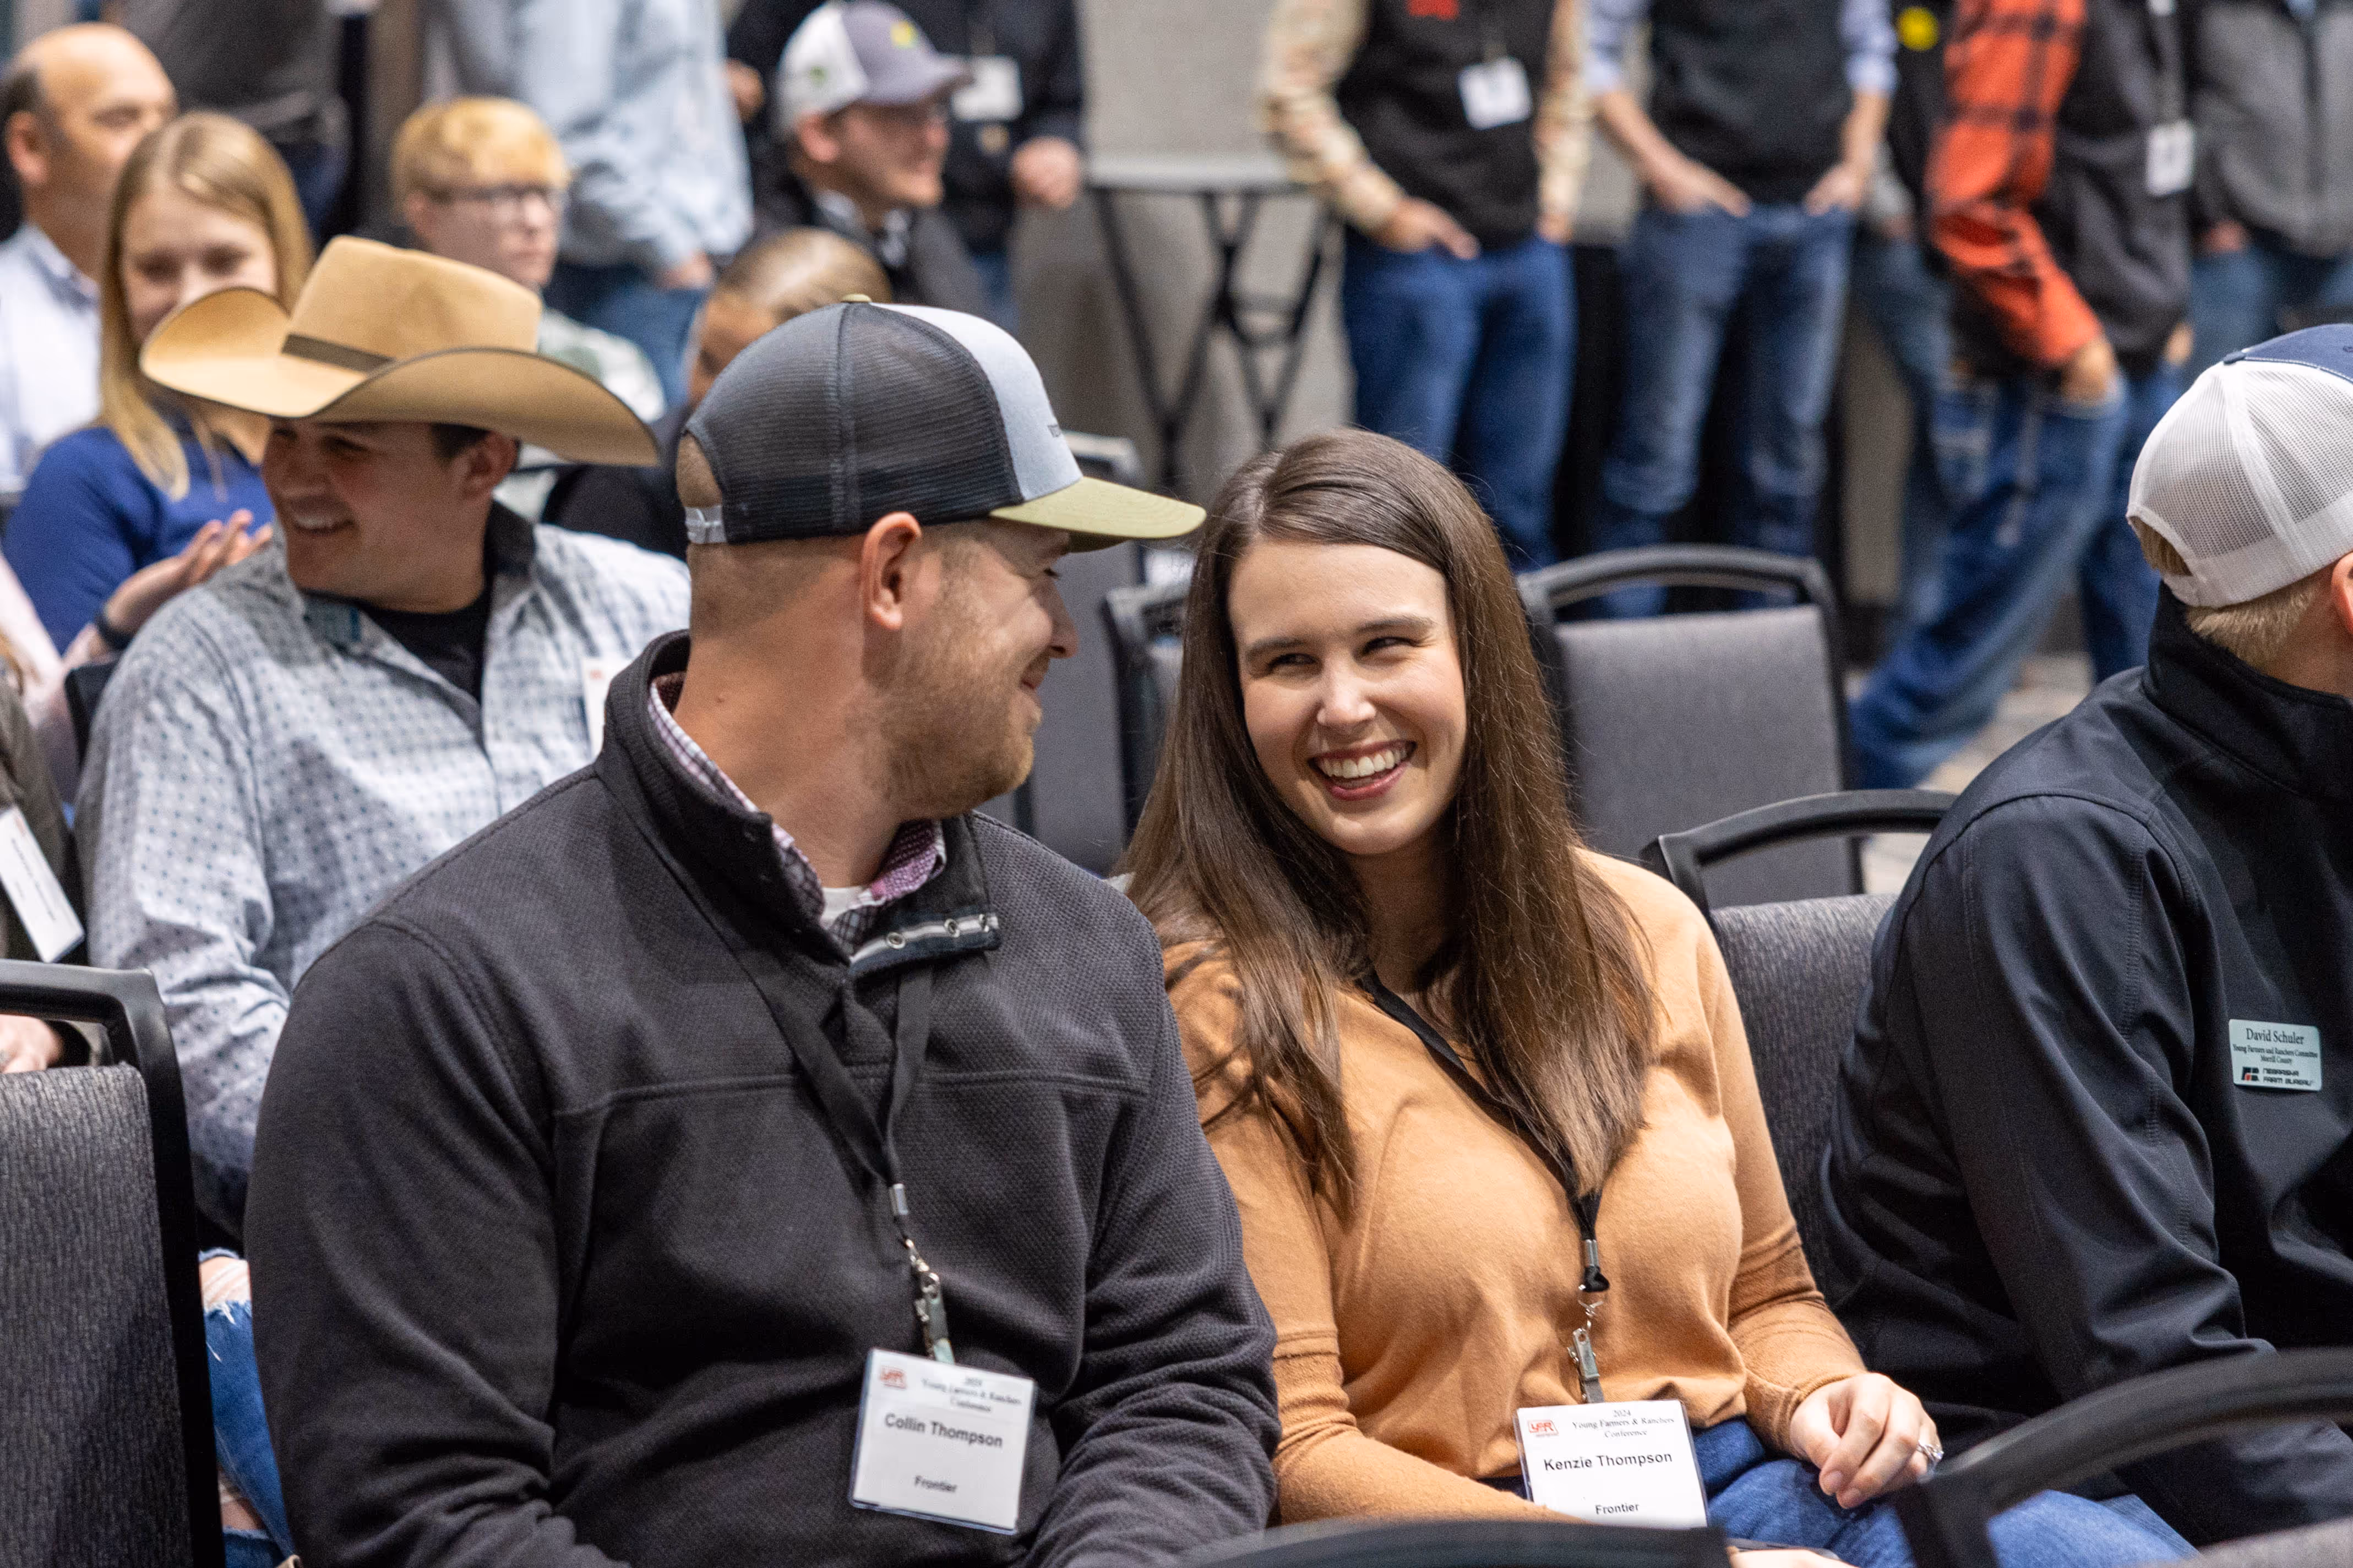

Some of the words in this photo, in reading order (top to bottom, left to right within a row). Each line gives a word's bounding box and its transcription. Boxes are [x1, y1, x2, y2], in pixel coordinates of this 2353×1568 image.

[2246, 1028, 2271, 1042] David
[2273, 1030, 2304, 1045] Schuler
[885, 1413, 926, 1433] Collin
[930, 1421, 1003, 1448] Thompson
[1572, 1421, 1598, 1429] Young
[1599, 1419, 1630, 1428] Farmers
[1544, 1458, 1593, 1471] Kenzie
[1597, 1452, 1673, 1468] Thompson
[914, 1475, 957, 1493] Frontier
[1595, 1502, 1640, 1515] Frontier
